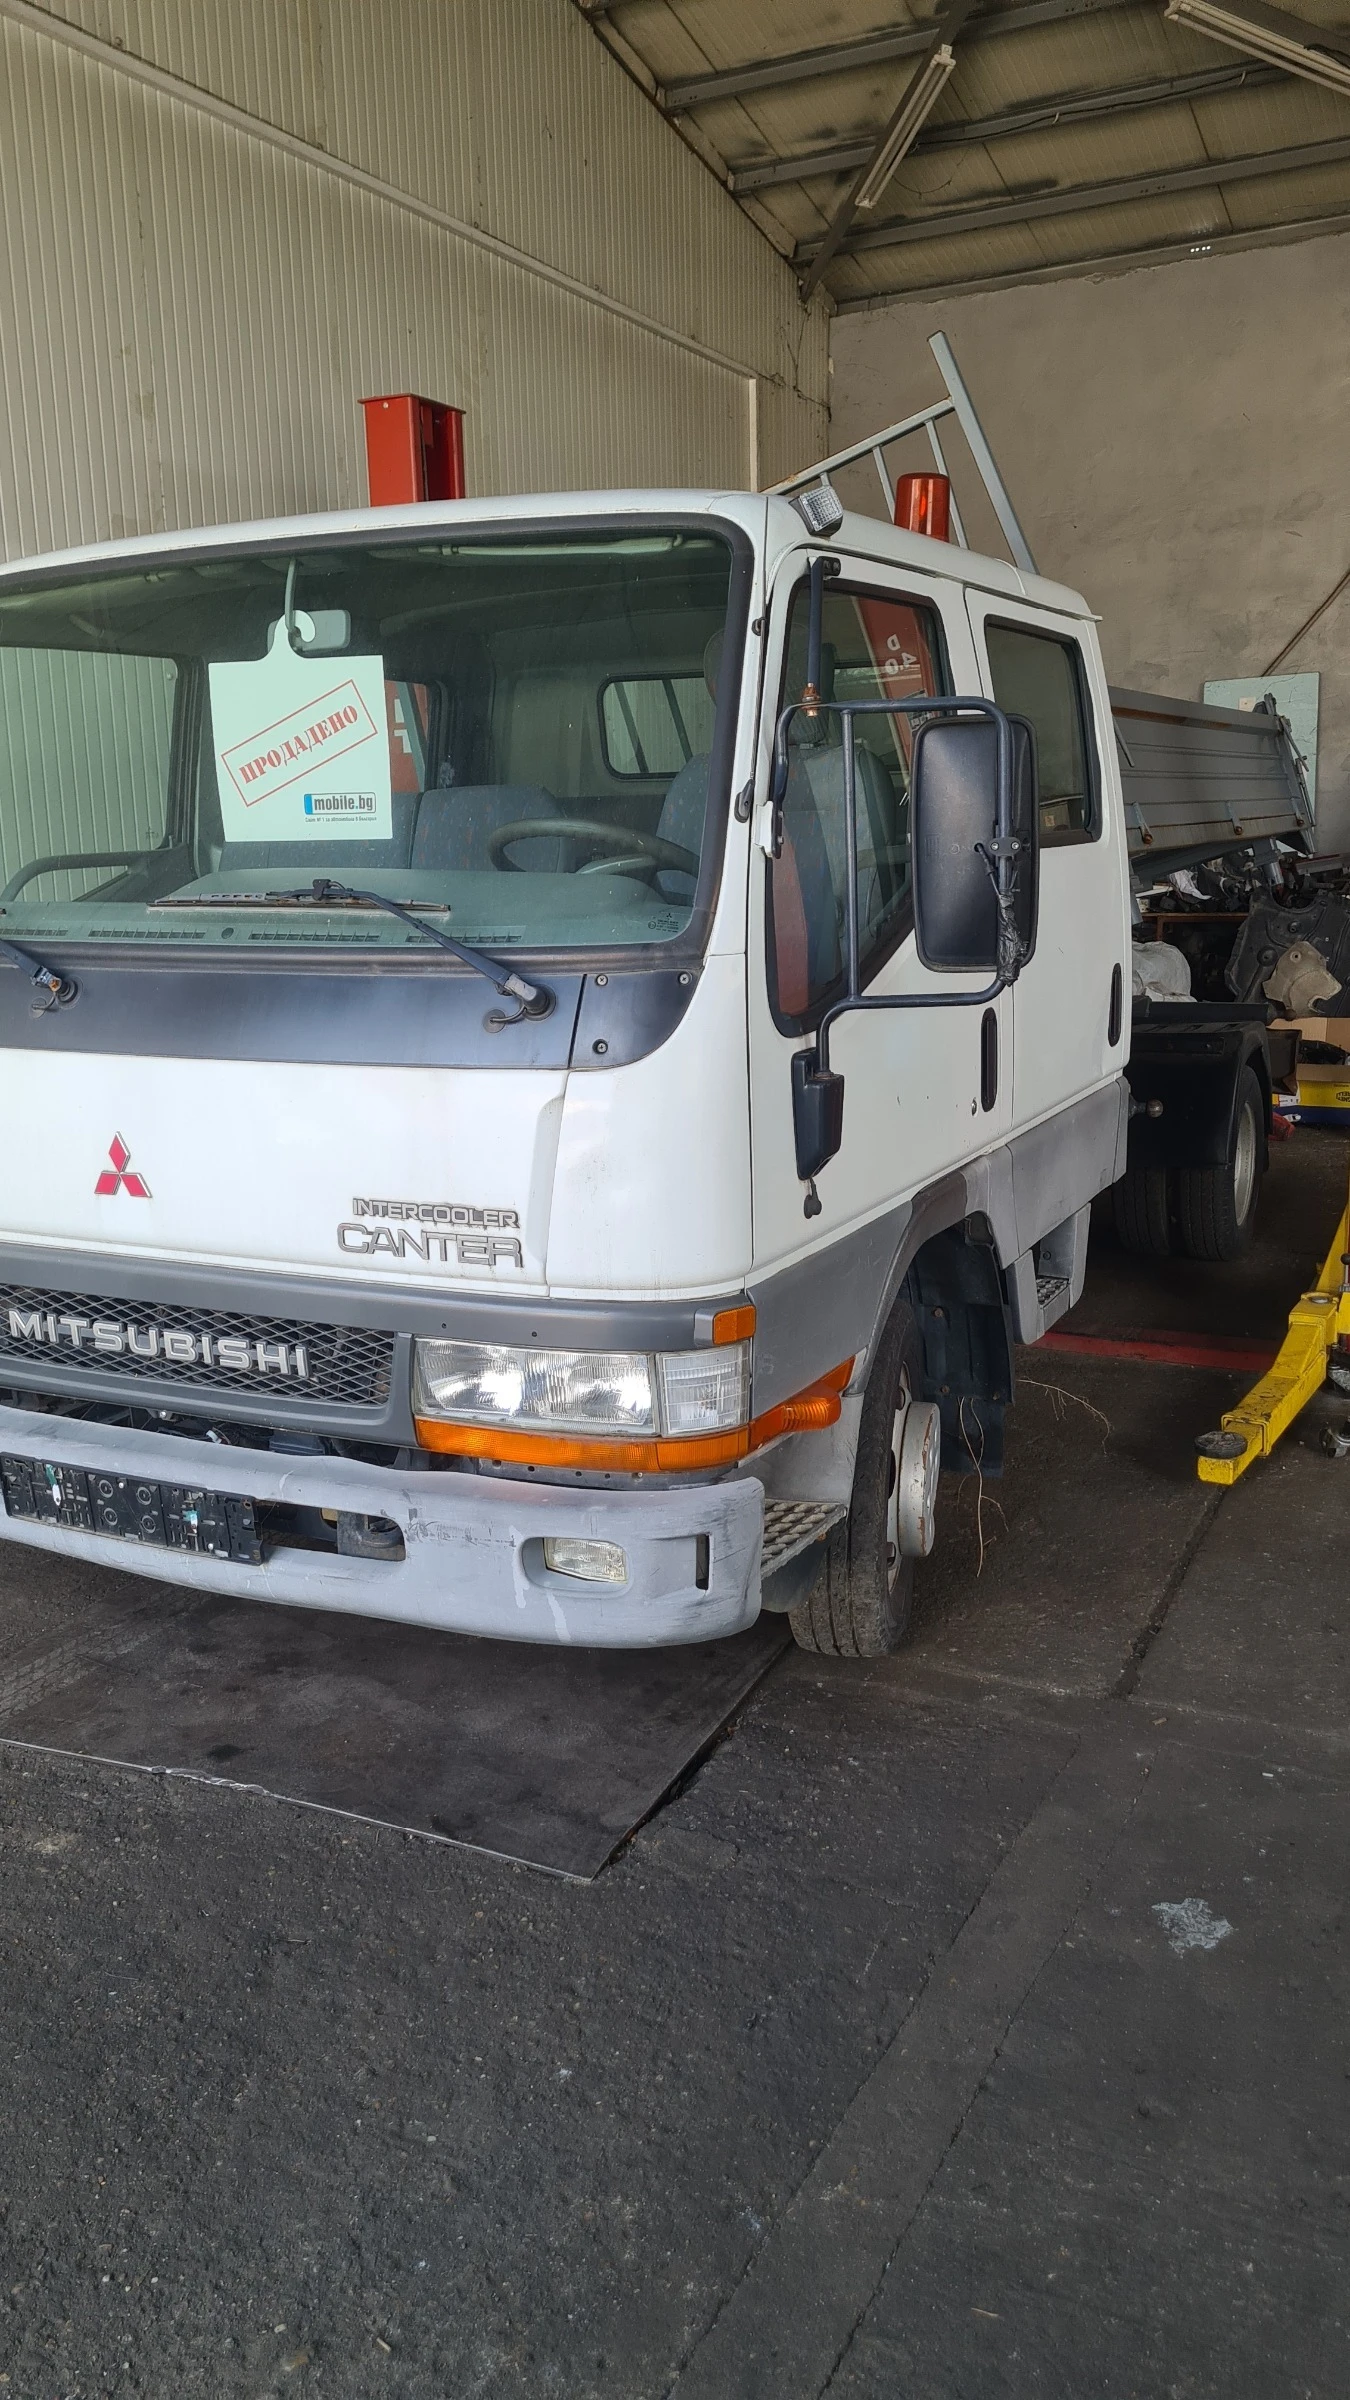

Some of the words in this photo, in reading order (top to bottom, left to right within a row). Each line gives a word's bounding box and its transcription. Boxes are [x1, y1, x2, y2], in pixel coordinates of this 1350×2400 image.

[238, 705, 358, 784] ПРОДАДЕНО
[314, 795, 373, 811] mobile.bg
[352, 1198, 521, 1229] INTERCOOLER
[336, 1222, 524, 1268] CANTER
[8, 1308, 311, 1378] MITSUBISHI
